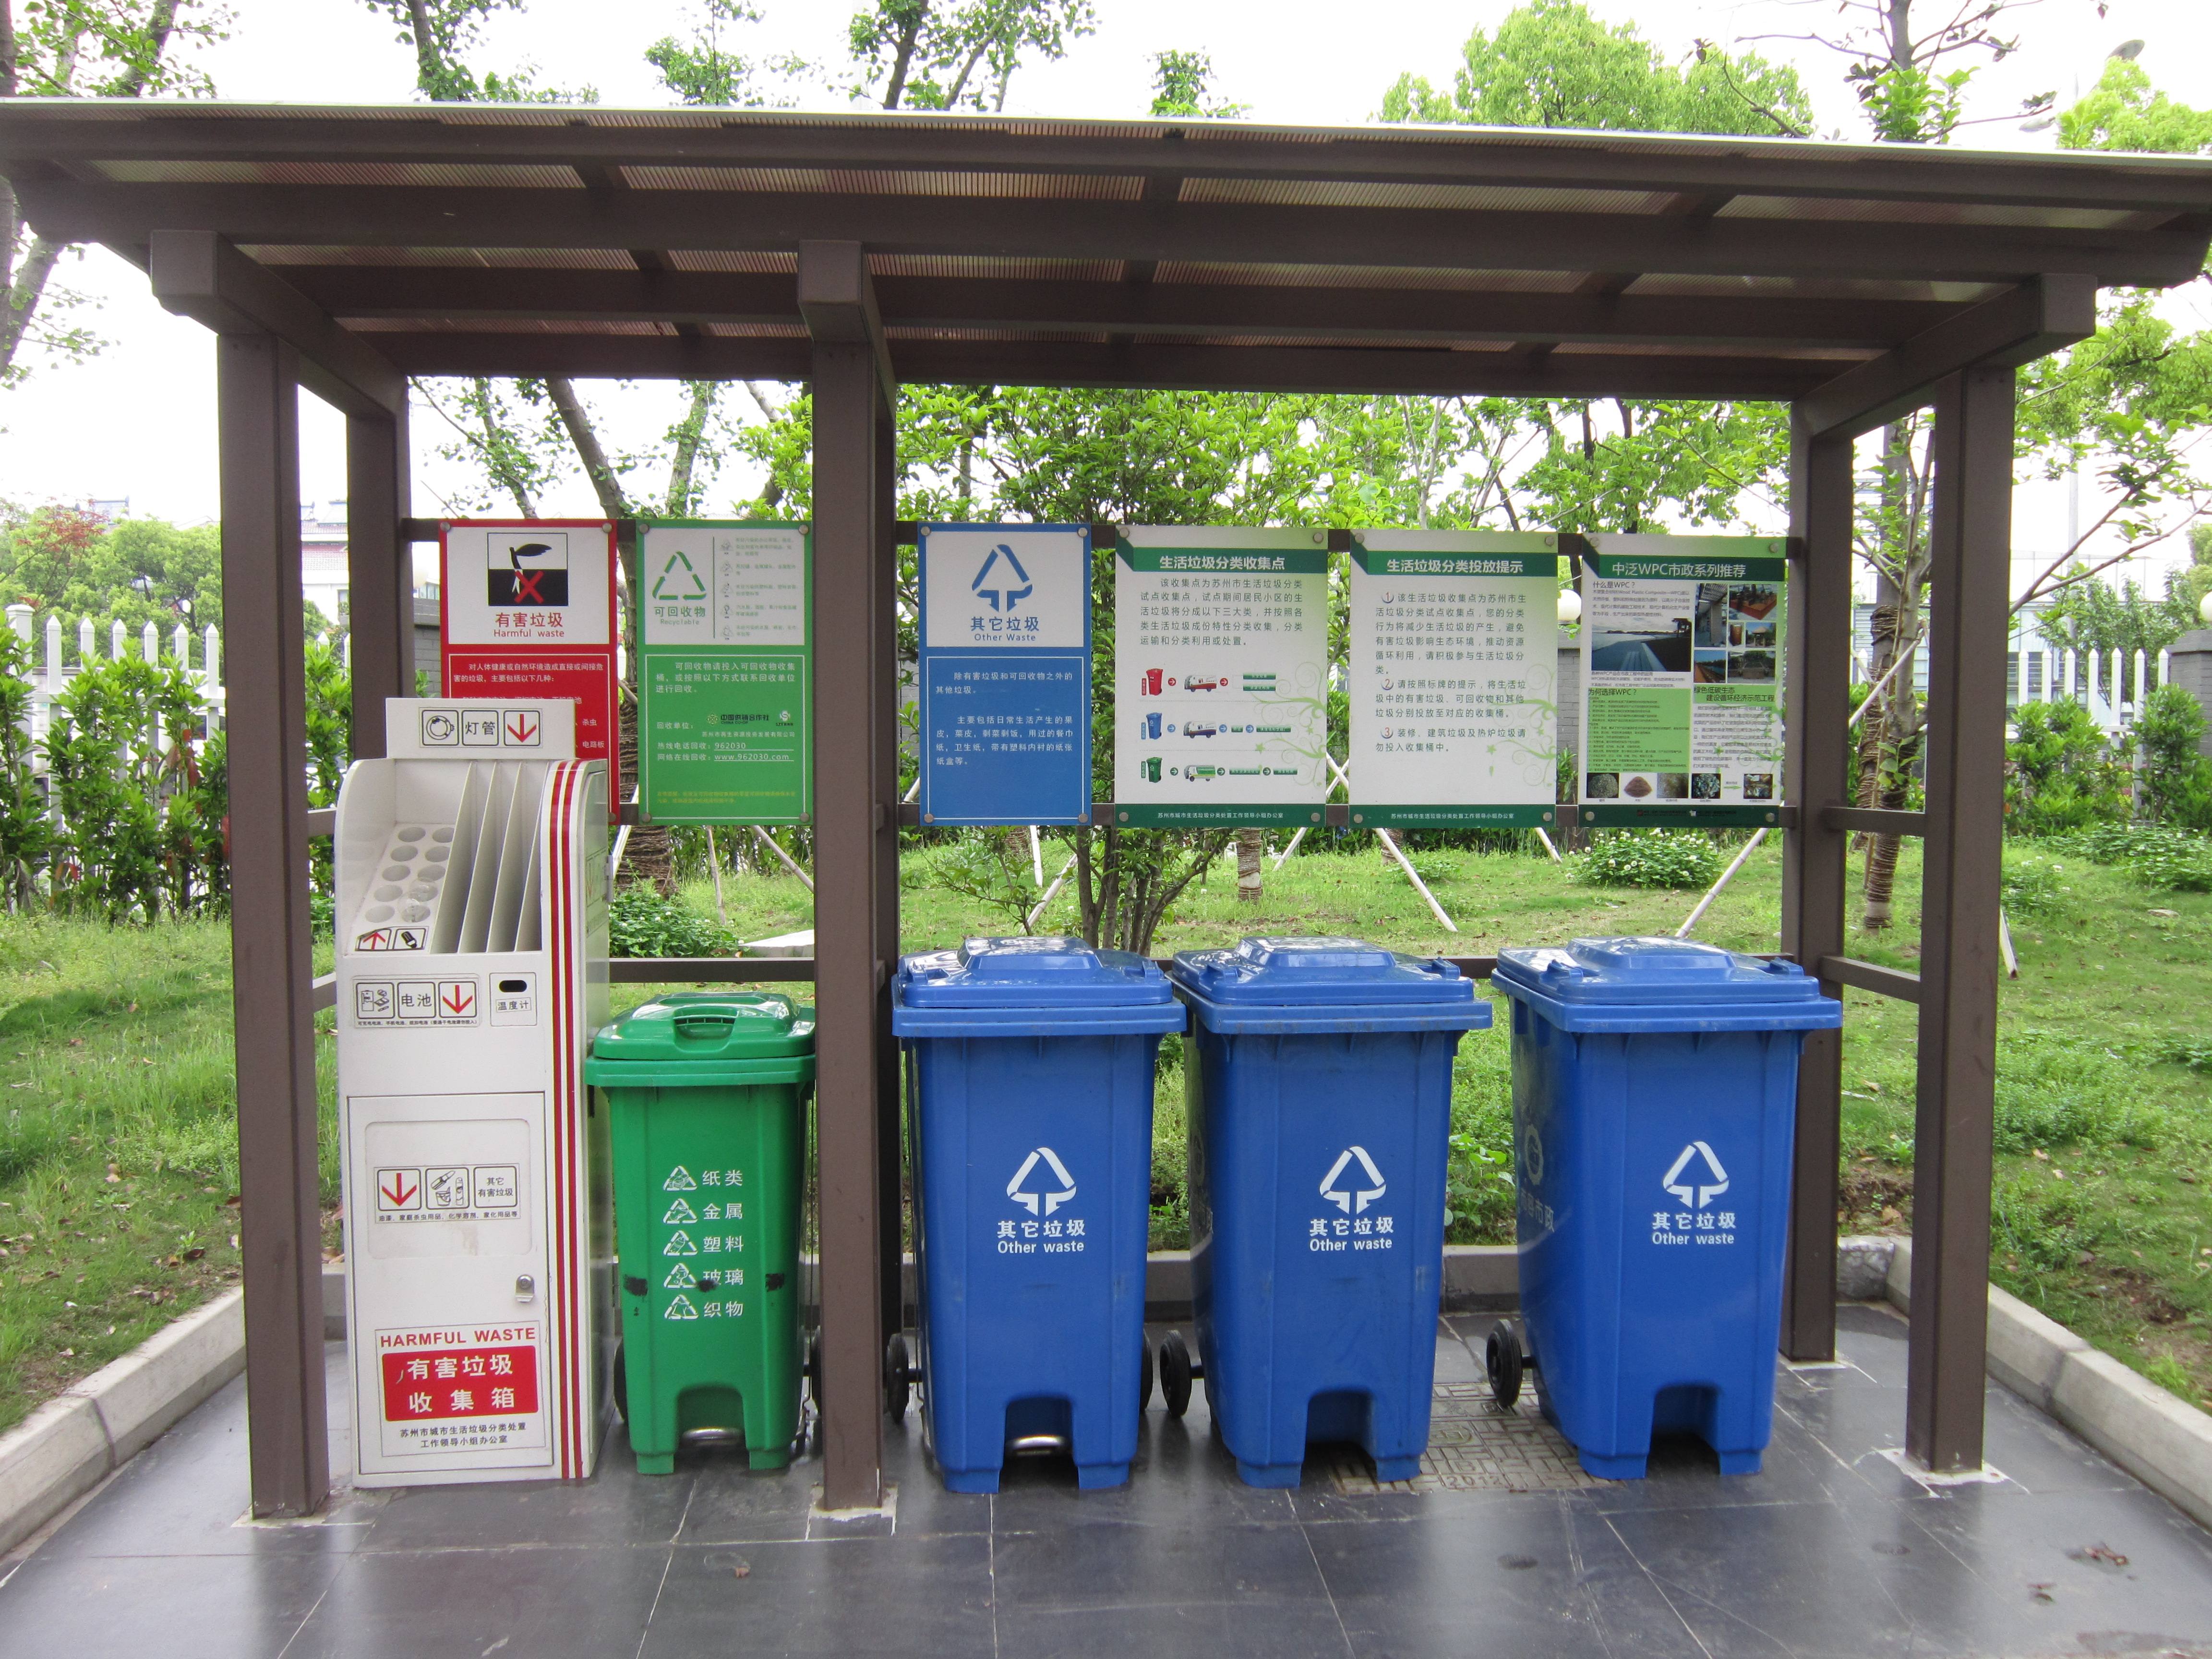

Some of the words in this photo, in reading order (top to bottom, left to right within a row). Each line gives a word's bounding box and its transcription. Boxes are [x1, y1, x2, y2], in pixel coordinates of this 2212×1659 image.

[1159, 556, 1285, 570] 生活垃圾分类收集点
[1386, 559, 1523, 573] 生活垃圾分类投放提示
[1612, 562, 1746, 577] 中泛WPC市政系列推荐
[1160, 578, 1302, 589] 该收集点为苏州市生活垃圾分类
[1140, 592, 1302, 602] 试点收集点，试点期间居民小区的生
[1397, 593, 1527, 603] 该生活垃圾收集点为苏州市生
[653, 606, 706, 618] 可回收物
[1140, 607, 1302, 617] 活垃圾将分成以下三大类，并按照各
[1376, 608, 1525, 617] 活垃圾分类试点收集点，您的分类
[495, 612, 563, 627] 有害垃圾
[970, 616, 1040, 632] 其它垃圾
[1140, 621, 1302, 632] 类生活垃圾成份特性分类收集，分类
[1376, 622, 1525, 632] 行为将减少生活垃圾的产生，避免
[493, 629, 531, 637] Harmful
[974, 633, 1002, 641] Other
[1006, 633, 1036, 641] Waste
[1140, 636, 1247, 646] 运输和分类利用或处置。
[1376, 637, 1525, 647] 有害垃圾影响生态环境，推动资源
[1376, 651, 1525, 661] 循环利用，请积极参与生活垃圾分
[469, 663, 603, 671] 对人体健康或自然环境造成直接或间接危
[675, 662, 795, 671] 可回收物请投入可回收物收集
[1376, 665, 1389, 674] 类。
[656, 673, 795, 682] 桶，或按照以下方式联系回收单位
[954, 672, 1073, 680] 除有害垃圾和可回收物之外的
[655, 685, 697, 693] 进行回收。
[936, 686, 976, 694] 其他垃圾。
[1397, 680, 1526, 689] 请按照标牌的提示，将生活垃
[1376, 694, 1524, 704] 圾中的有害垃圾、可回收物和其他
[1376, 709, 1510, 718] 垃圾分别投放至对应的收集桶。
[957, 716, 1073, 724] 主要包括日常生活产生的果
[465, 721, 496, 735] 灯管
[1376, 743, 1450, 752] 勿投入收集桶中。
[937, 757, 968, 765] 纸盒等。
[401, 993, 432, 1008] 电池
[497, 1000, 531, 1011] 温度计
[487, 1177, 505, 1186] 其它
[702, 1169, 743, 1187] 纸类
[478, 1188, 514, 1198] 有害垃圾
[703, 1202, 743, 1220] 金属
[1309, 1216, 1394, 1237] 其它垃圾
[1651, 1212, 1736, 1231] 其它垃圾
[997, 1219, 1086, 1239] 其它垃圾
[1652, 1232, 1690, 1245] Other
[1695, 1232, 1734, 1244] waste
[703, 1236, 744, 1253] 塑料
[998, 1240, 1036, 1254] Other
[1043, 1240, 1084, 1253] waste
[1309, 1238, 1347, 1252] Other
[1353, 1237, 1392, 1250] waste
[702, 1268, 744, 1286] 玻璃
[703, 1301, 744, 1318] 织物
[380, 1331, 467, 1348] HARMFUL
[474, 1327, 536, 1343] WASTE
[406, 1354, 514, 1381] 有害垃圾
[409, 1386, 516, 1414] 收集箱
[399, 1422, 527, 1438] 苏州市城市生活垃圾分类处置
[421, 1435, 508, 1448] 工作领导小组办公室
